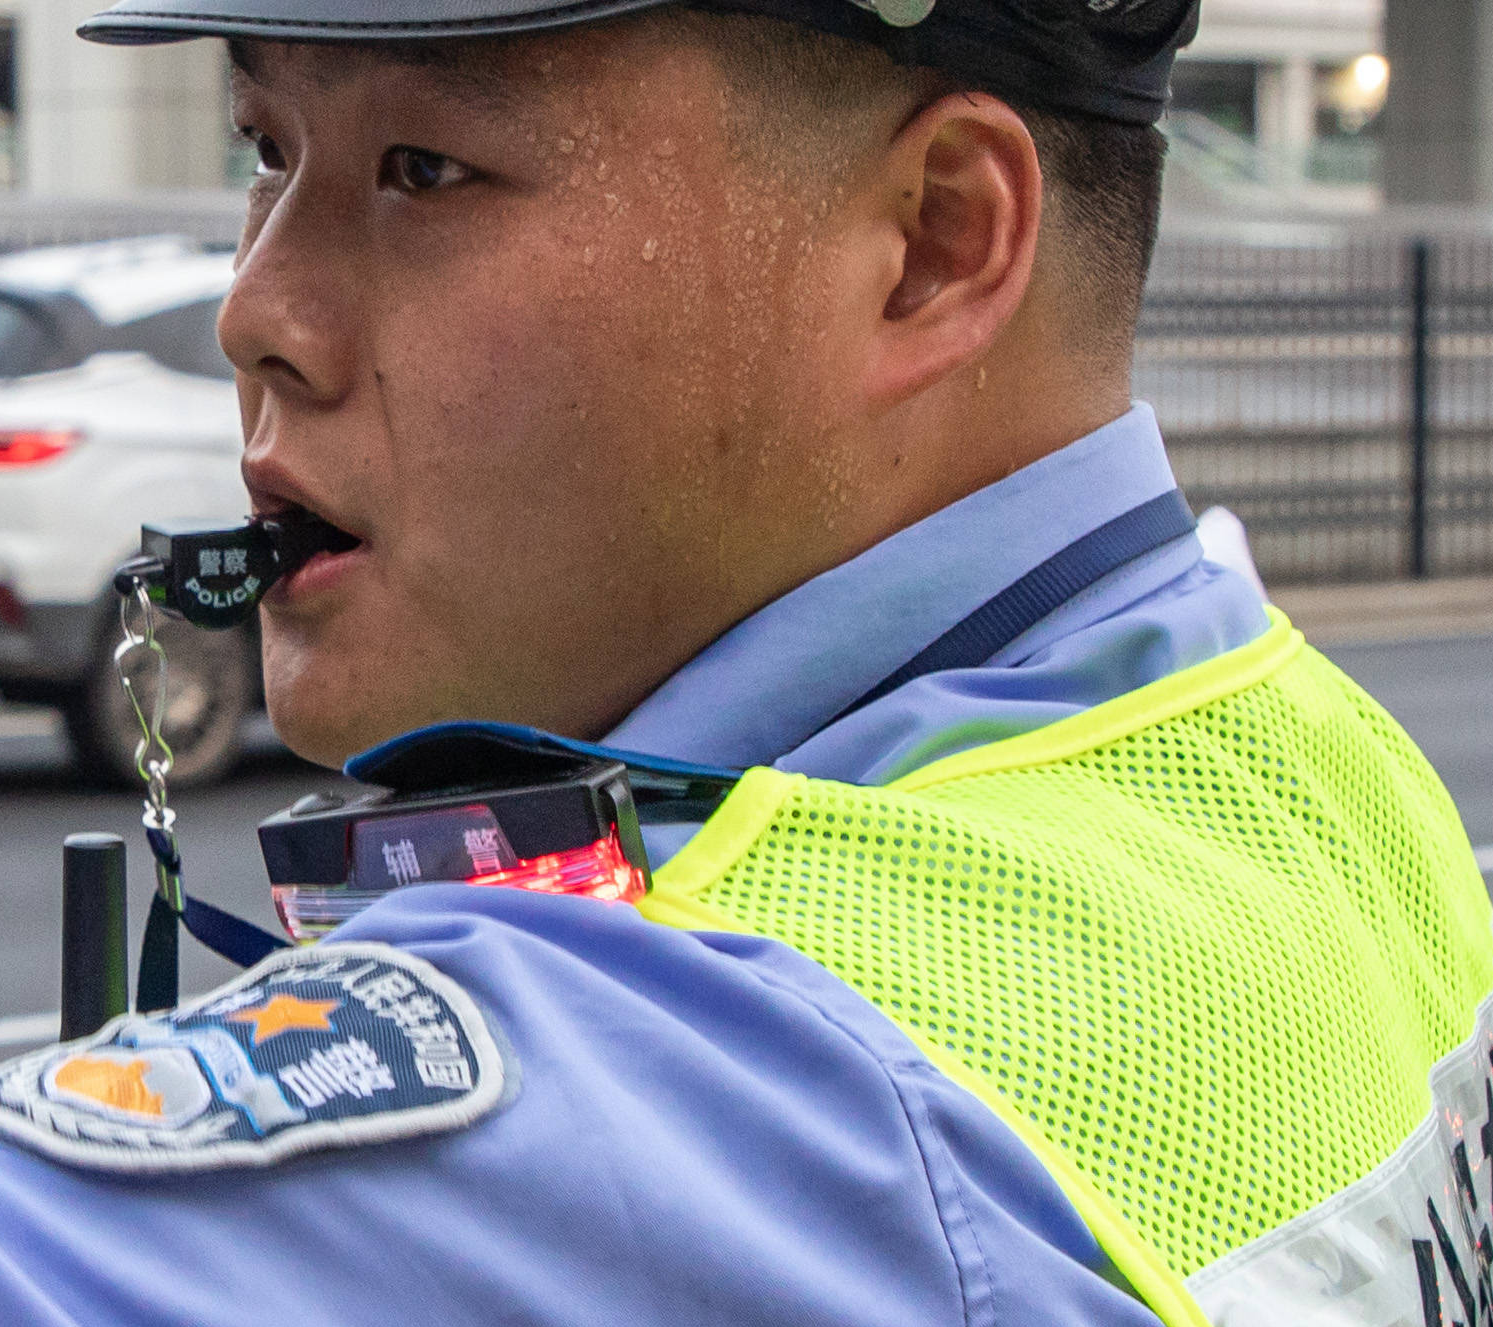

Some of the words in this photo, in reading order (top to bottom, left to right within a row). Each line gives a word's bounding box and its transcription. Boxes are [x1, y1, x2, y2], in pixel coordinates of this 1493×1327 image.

[198, 547, 248, 577] 警察
[184, 575, 262, 610] POLICE
[381, 827, 502, 887] 辅警
